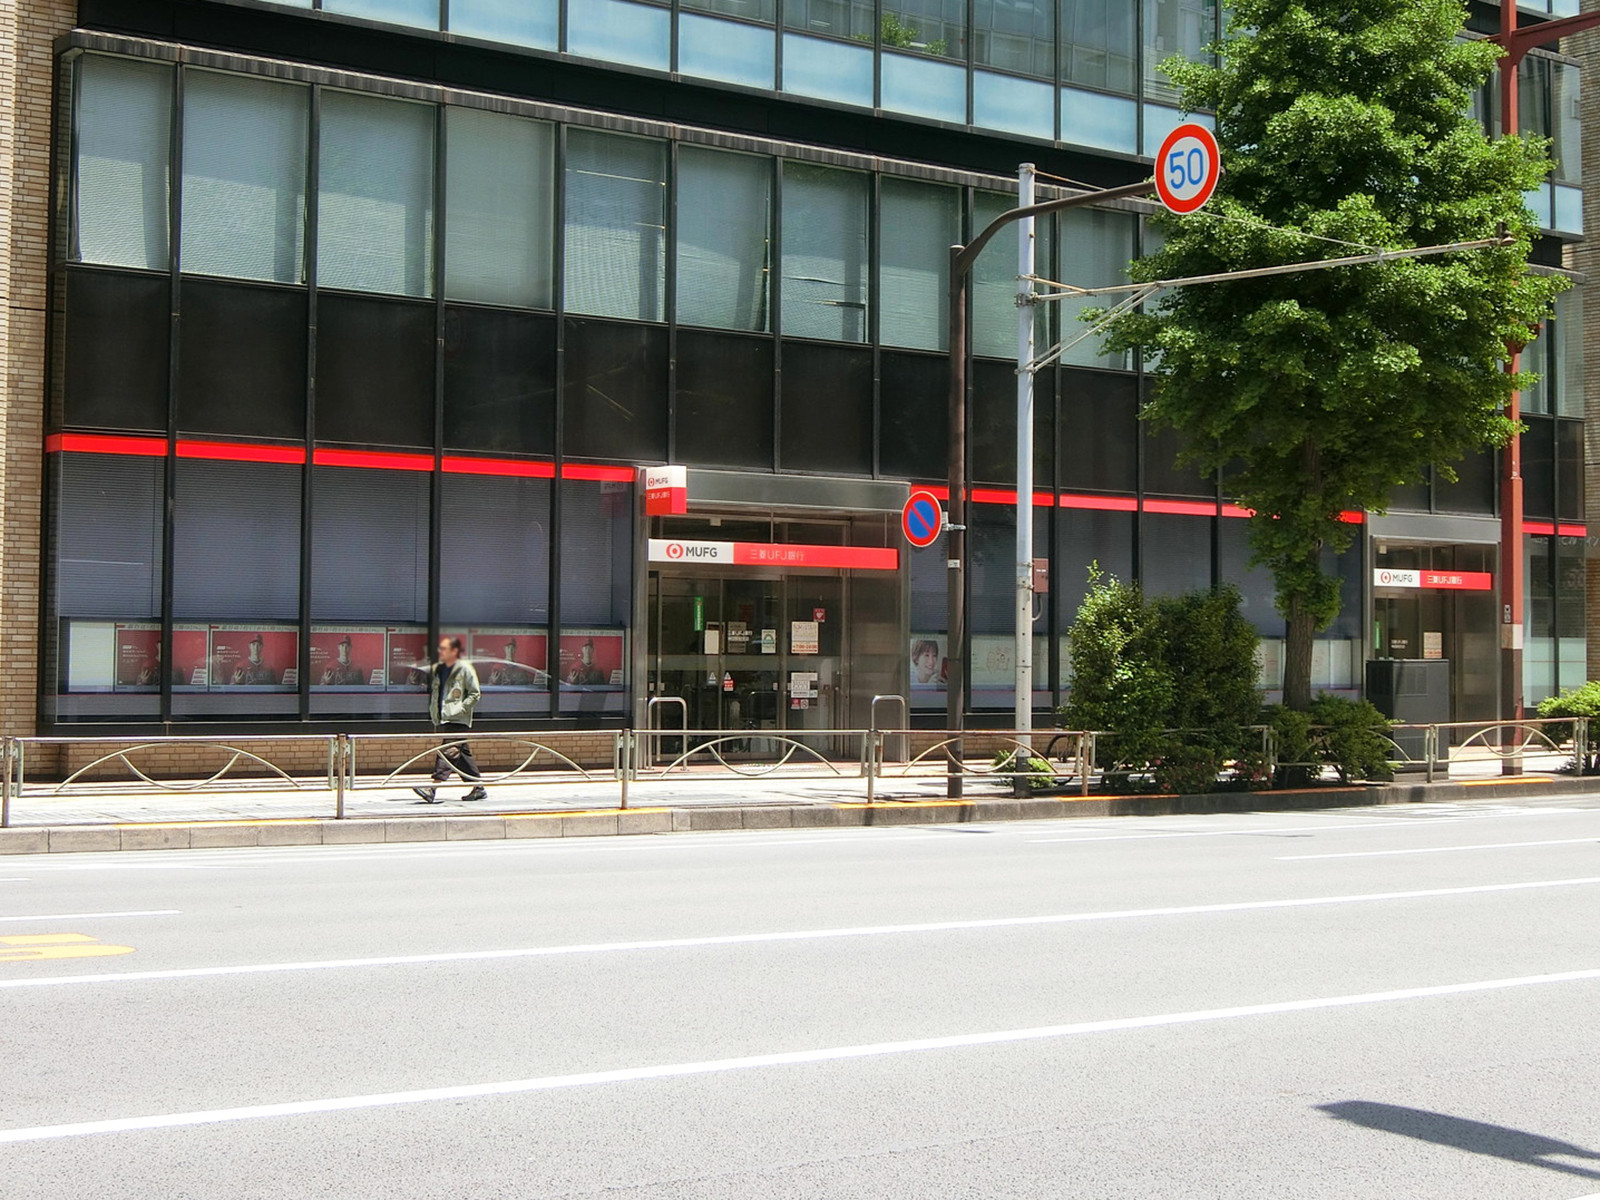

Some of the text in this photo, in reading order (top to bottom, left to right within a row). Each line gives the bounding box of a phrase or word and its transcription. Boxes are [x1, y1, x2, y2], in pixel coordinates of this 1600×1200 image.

[1169, 147, 1204, 190] 50
[685, 547, 718, 558] MUFG
[1392, 574, 1413, 583] MUFG
